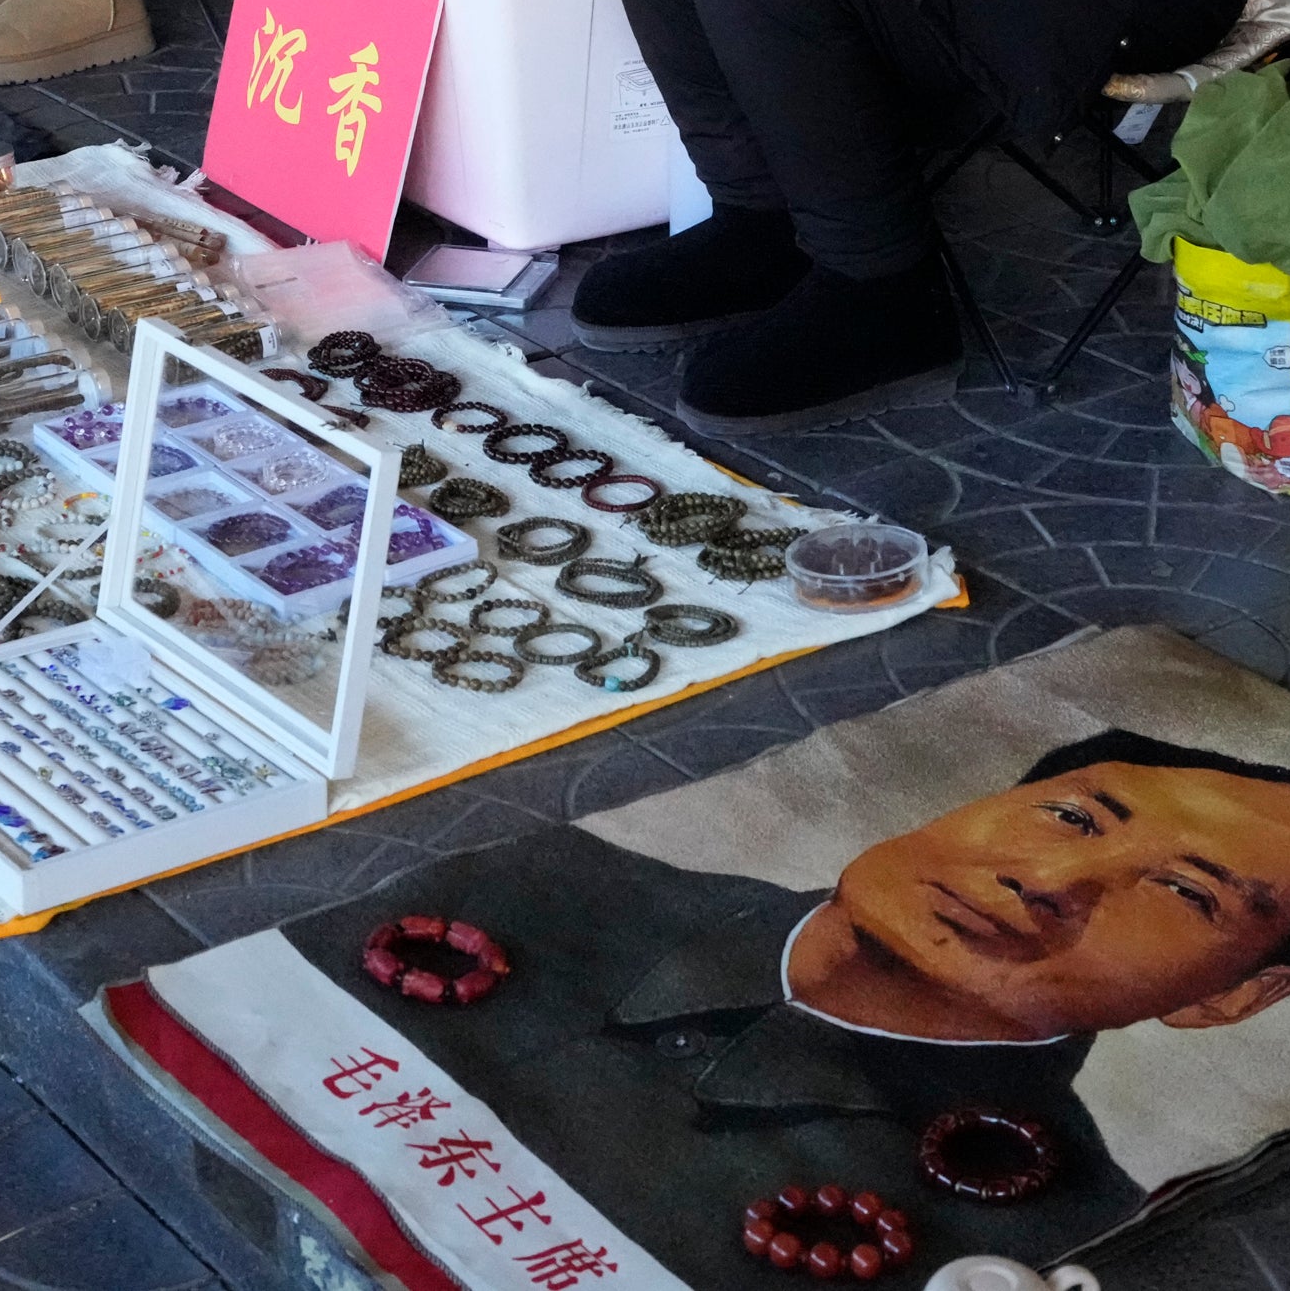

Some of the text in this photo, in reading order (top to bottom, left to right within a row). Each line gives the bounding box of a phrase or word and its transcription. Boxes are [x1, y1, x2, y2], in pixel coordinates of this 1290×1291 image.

[246, 6, 383, 178] 沉香
[322, 1046, 618, 1291] 毛泽东主席
